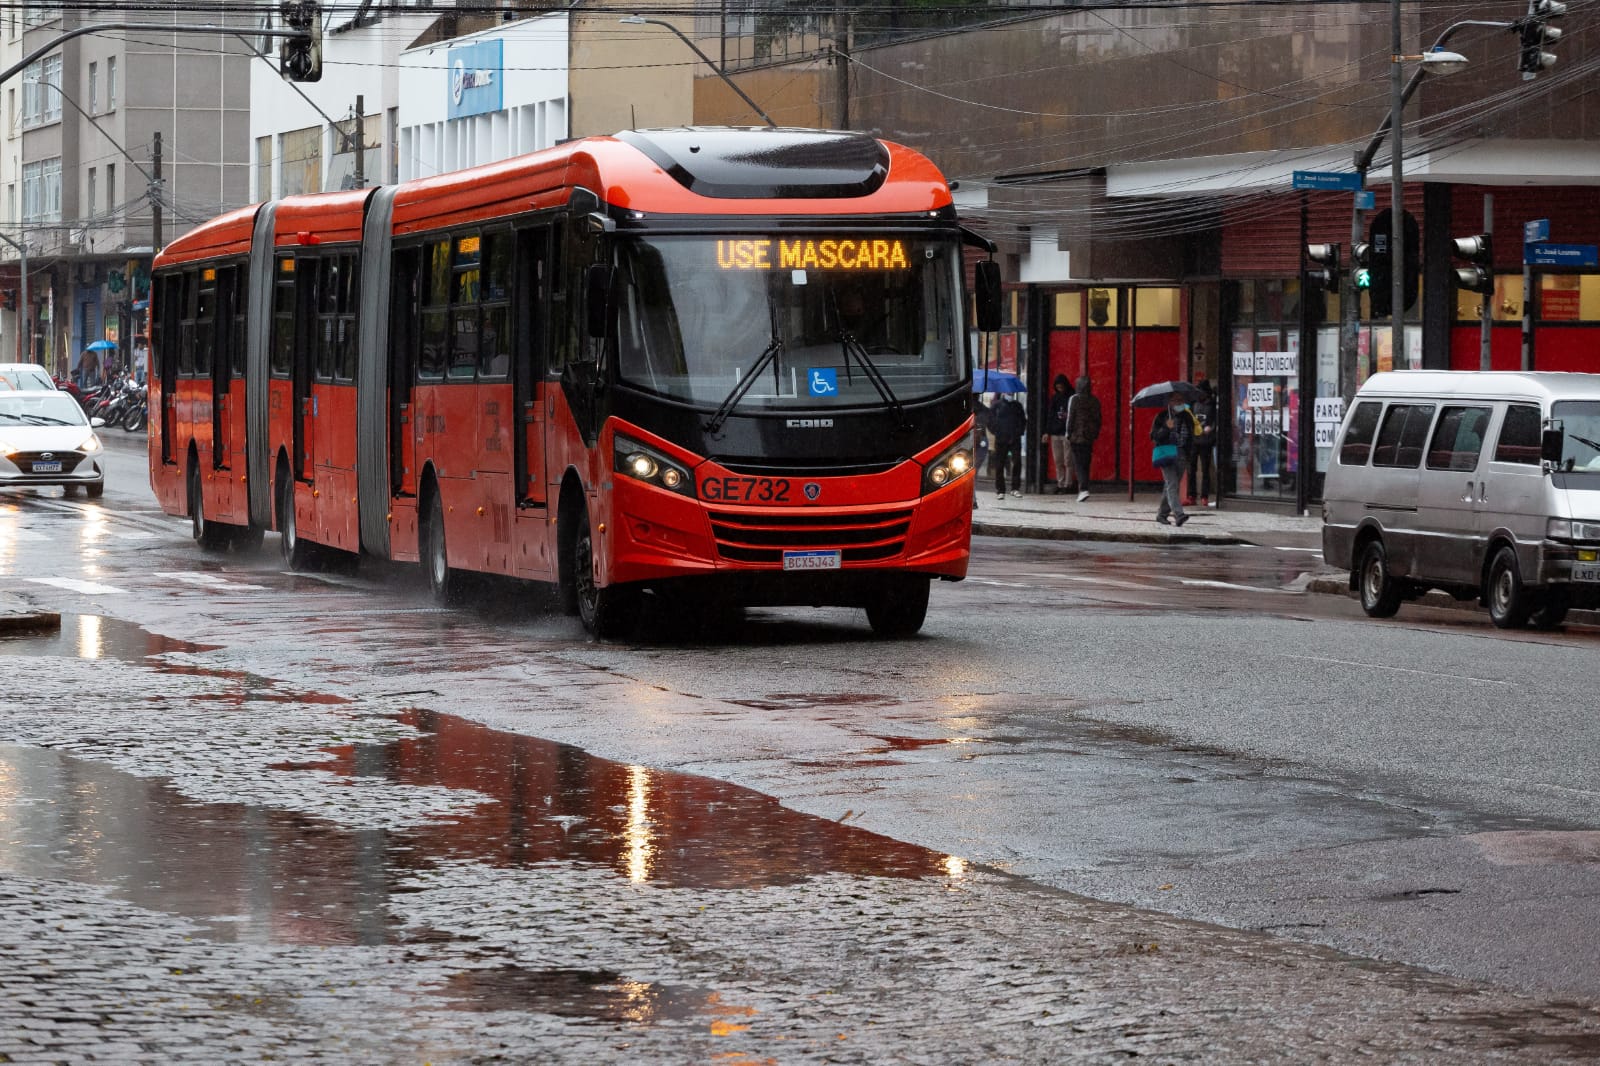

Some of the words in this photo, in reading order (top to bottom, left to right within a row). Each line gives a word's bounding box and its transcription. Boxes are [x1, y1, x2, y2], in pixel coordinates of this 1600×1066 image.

[717, 240, 771, 268] USE
[780, 240, 907, 268] MASCARA
[786, 419, 834, 428] CAIO
[701, 477, 790, 502] GE732
[788, 557, 835, 569] BCX5J43
